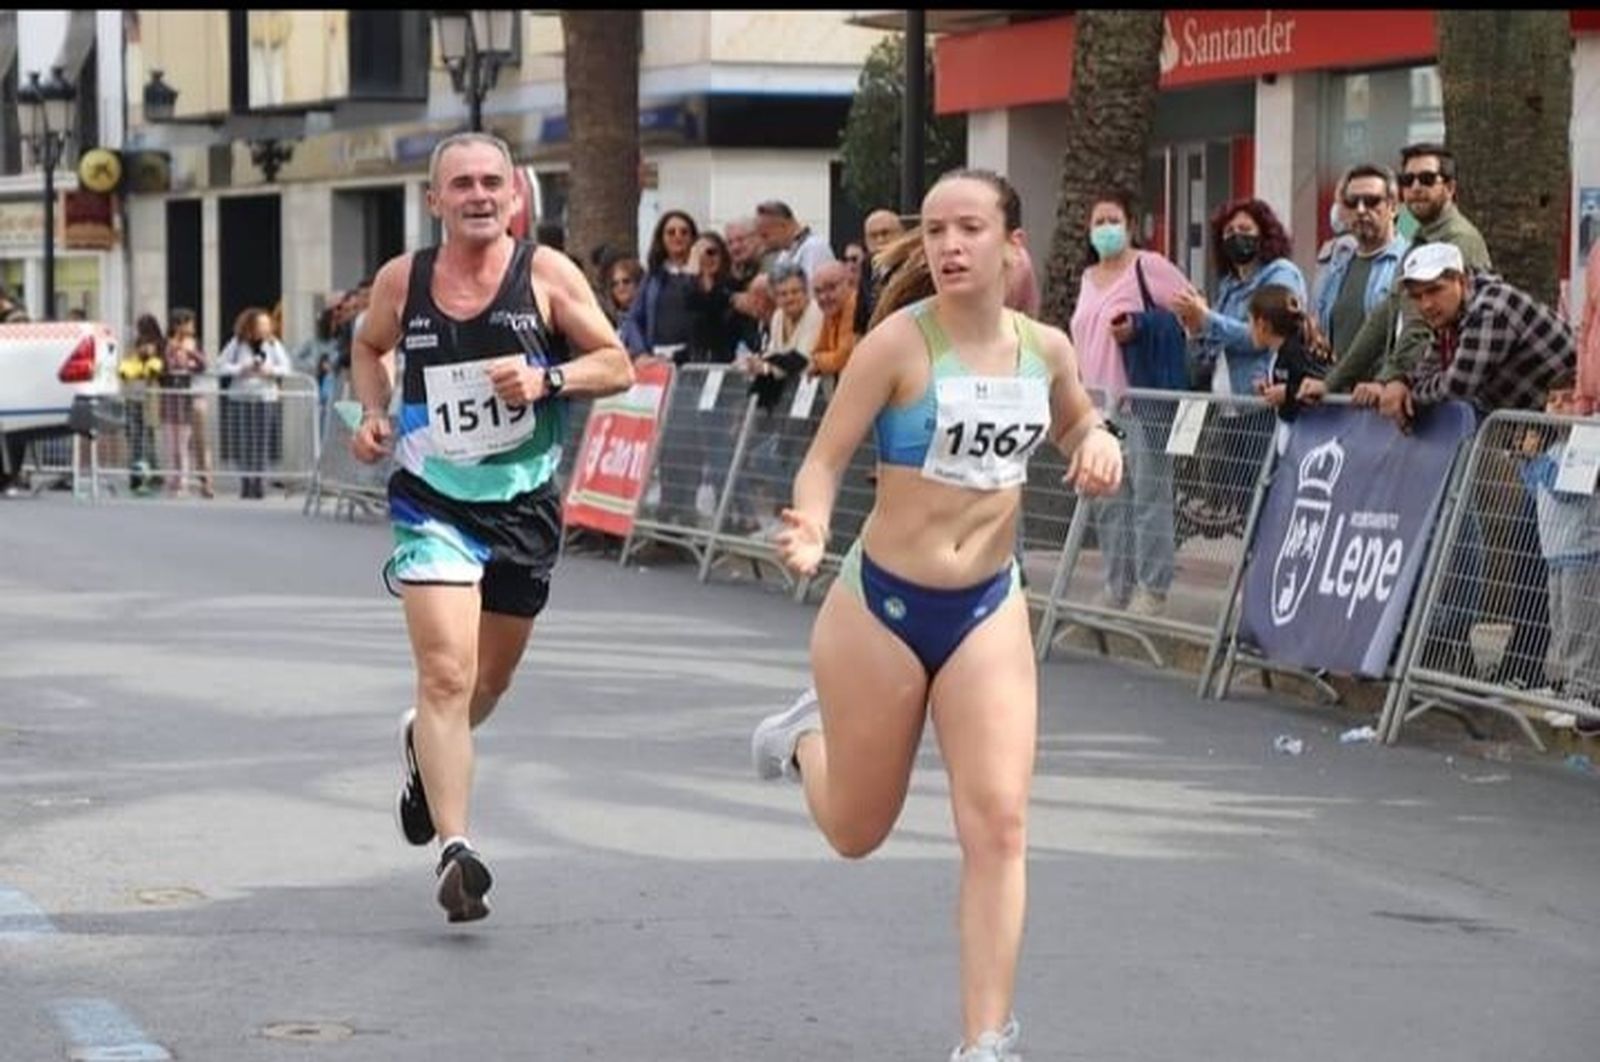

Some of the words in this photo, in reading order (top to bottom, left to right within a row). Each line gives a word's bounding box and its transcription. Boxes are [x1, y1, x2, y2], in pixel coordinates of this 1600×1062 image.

[1182, 11, 1296, 67] Santander
[435, 396, 528, 434] 1519
[946, 420, 1045, 458] 1567
[1318, 513, 1403, 620] Lepe
